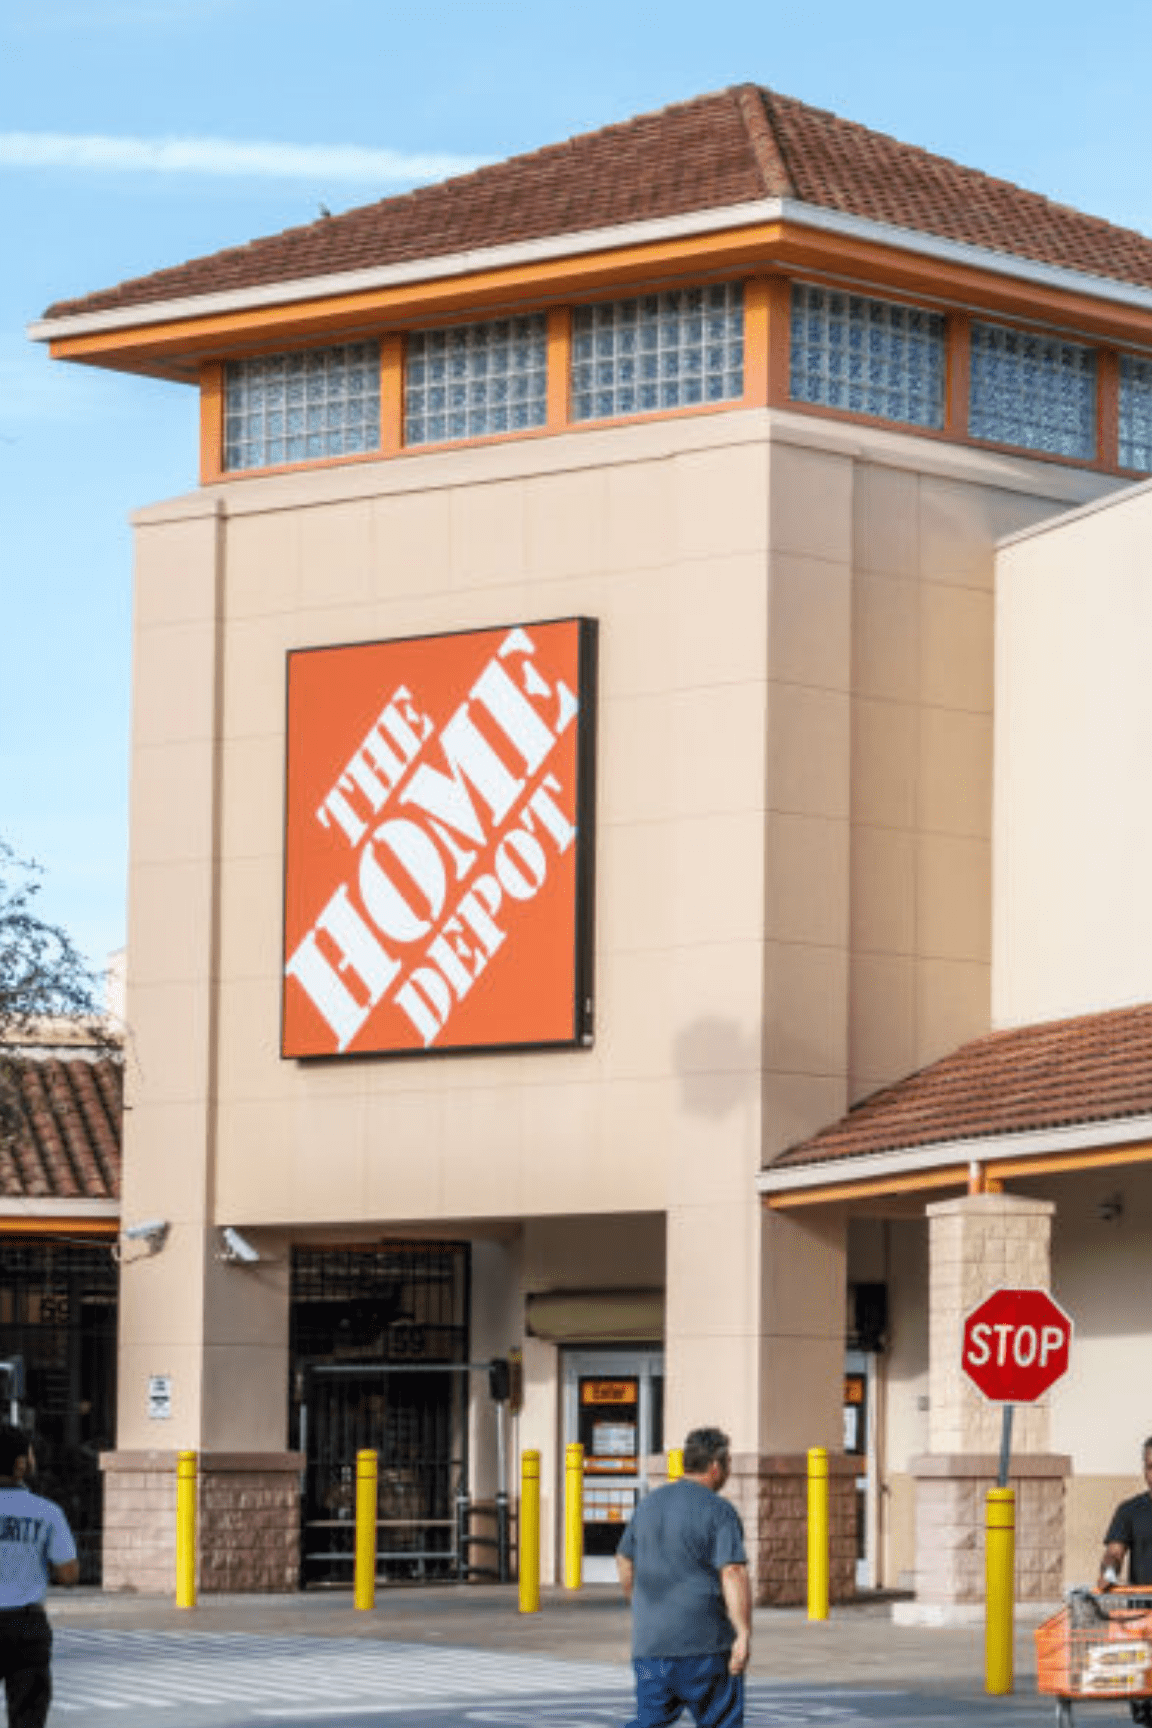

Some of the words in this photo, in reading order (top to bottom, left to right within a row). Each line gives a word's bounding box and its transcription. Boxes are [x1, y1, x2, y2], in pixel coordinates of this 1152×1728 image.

[285, 626, 579, 1054] HOME
[315, 684, 435, 848] THE
[392, 772, 578, 1049] DEPOT
[966, 1322, 1065, 1368] STOP
